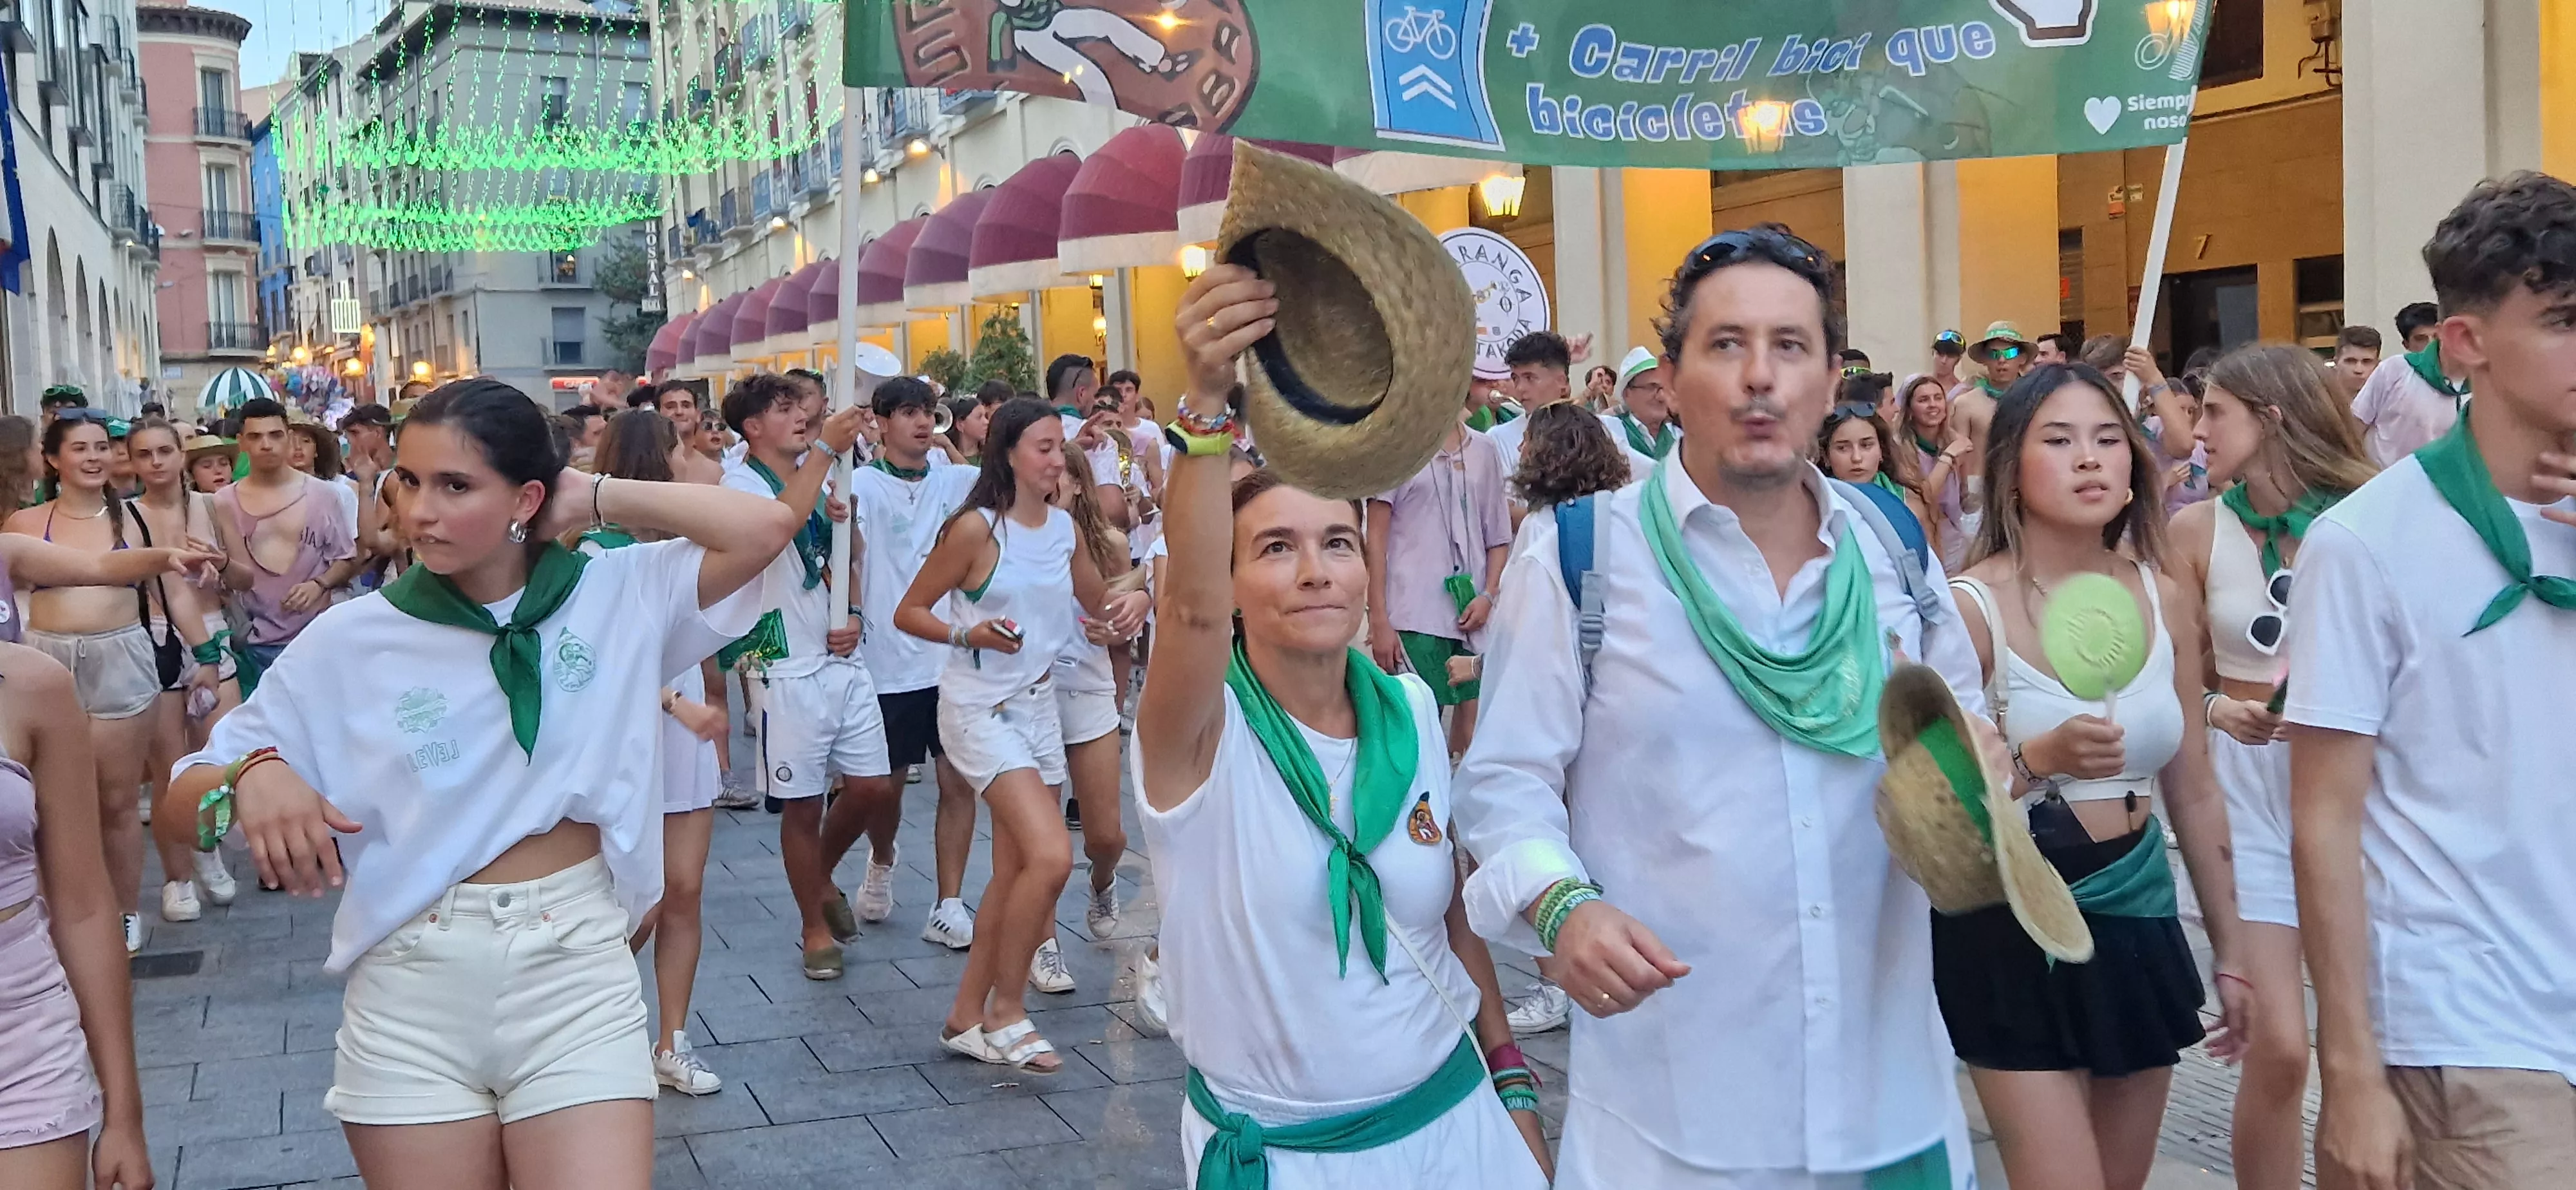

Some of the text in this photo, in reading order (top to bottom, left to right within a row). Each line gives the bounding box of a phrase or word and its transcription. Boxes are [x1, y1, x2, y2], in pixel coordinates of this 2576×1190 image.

[1569, 24, 1763, 84] Carril
[1766, 32, 1872, 77] bici
[1886, 20, 1996, 77] que
[645, 221, 659, 296] HOSTAL
[1455, 244, 1533, 303] RANGA
[2192, 233, 2213, 260] 7
[406, 739, 460, 773] LEVEL
